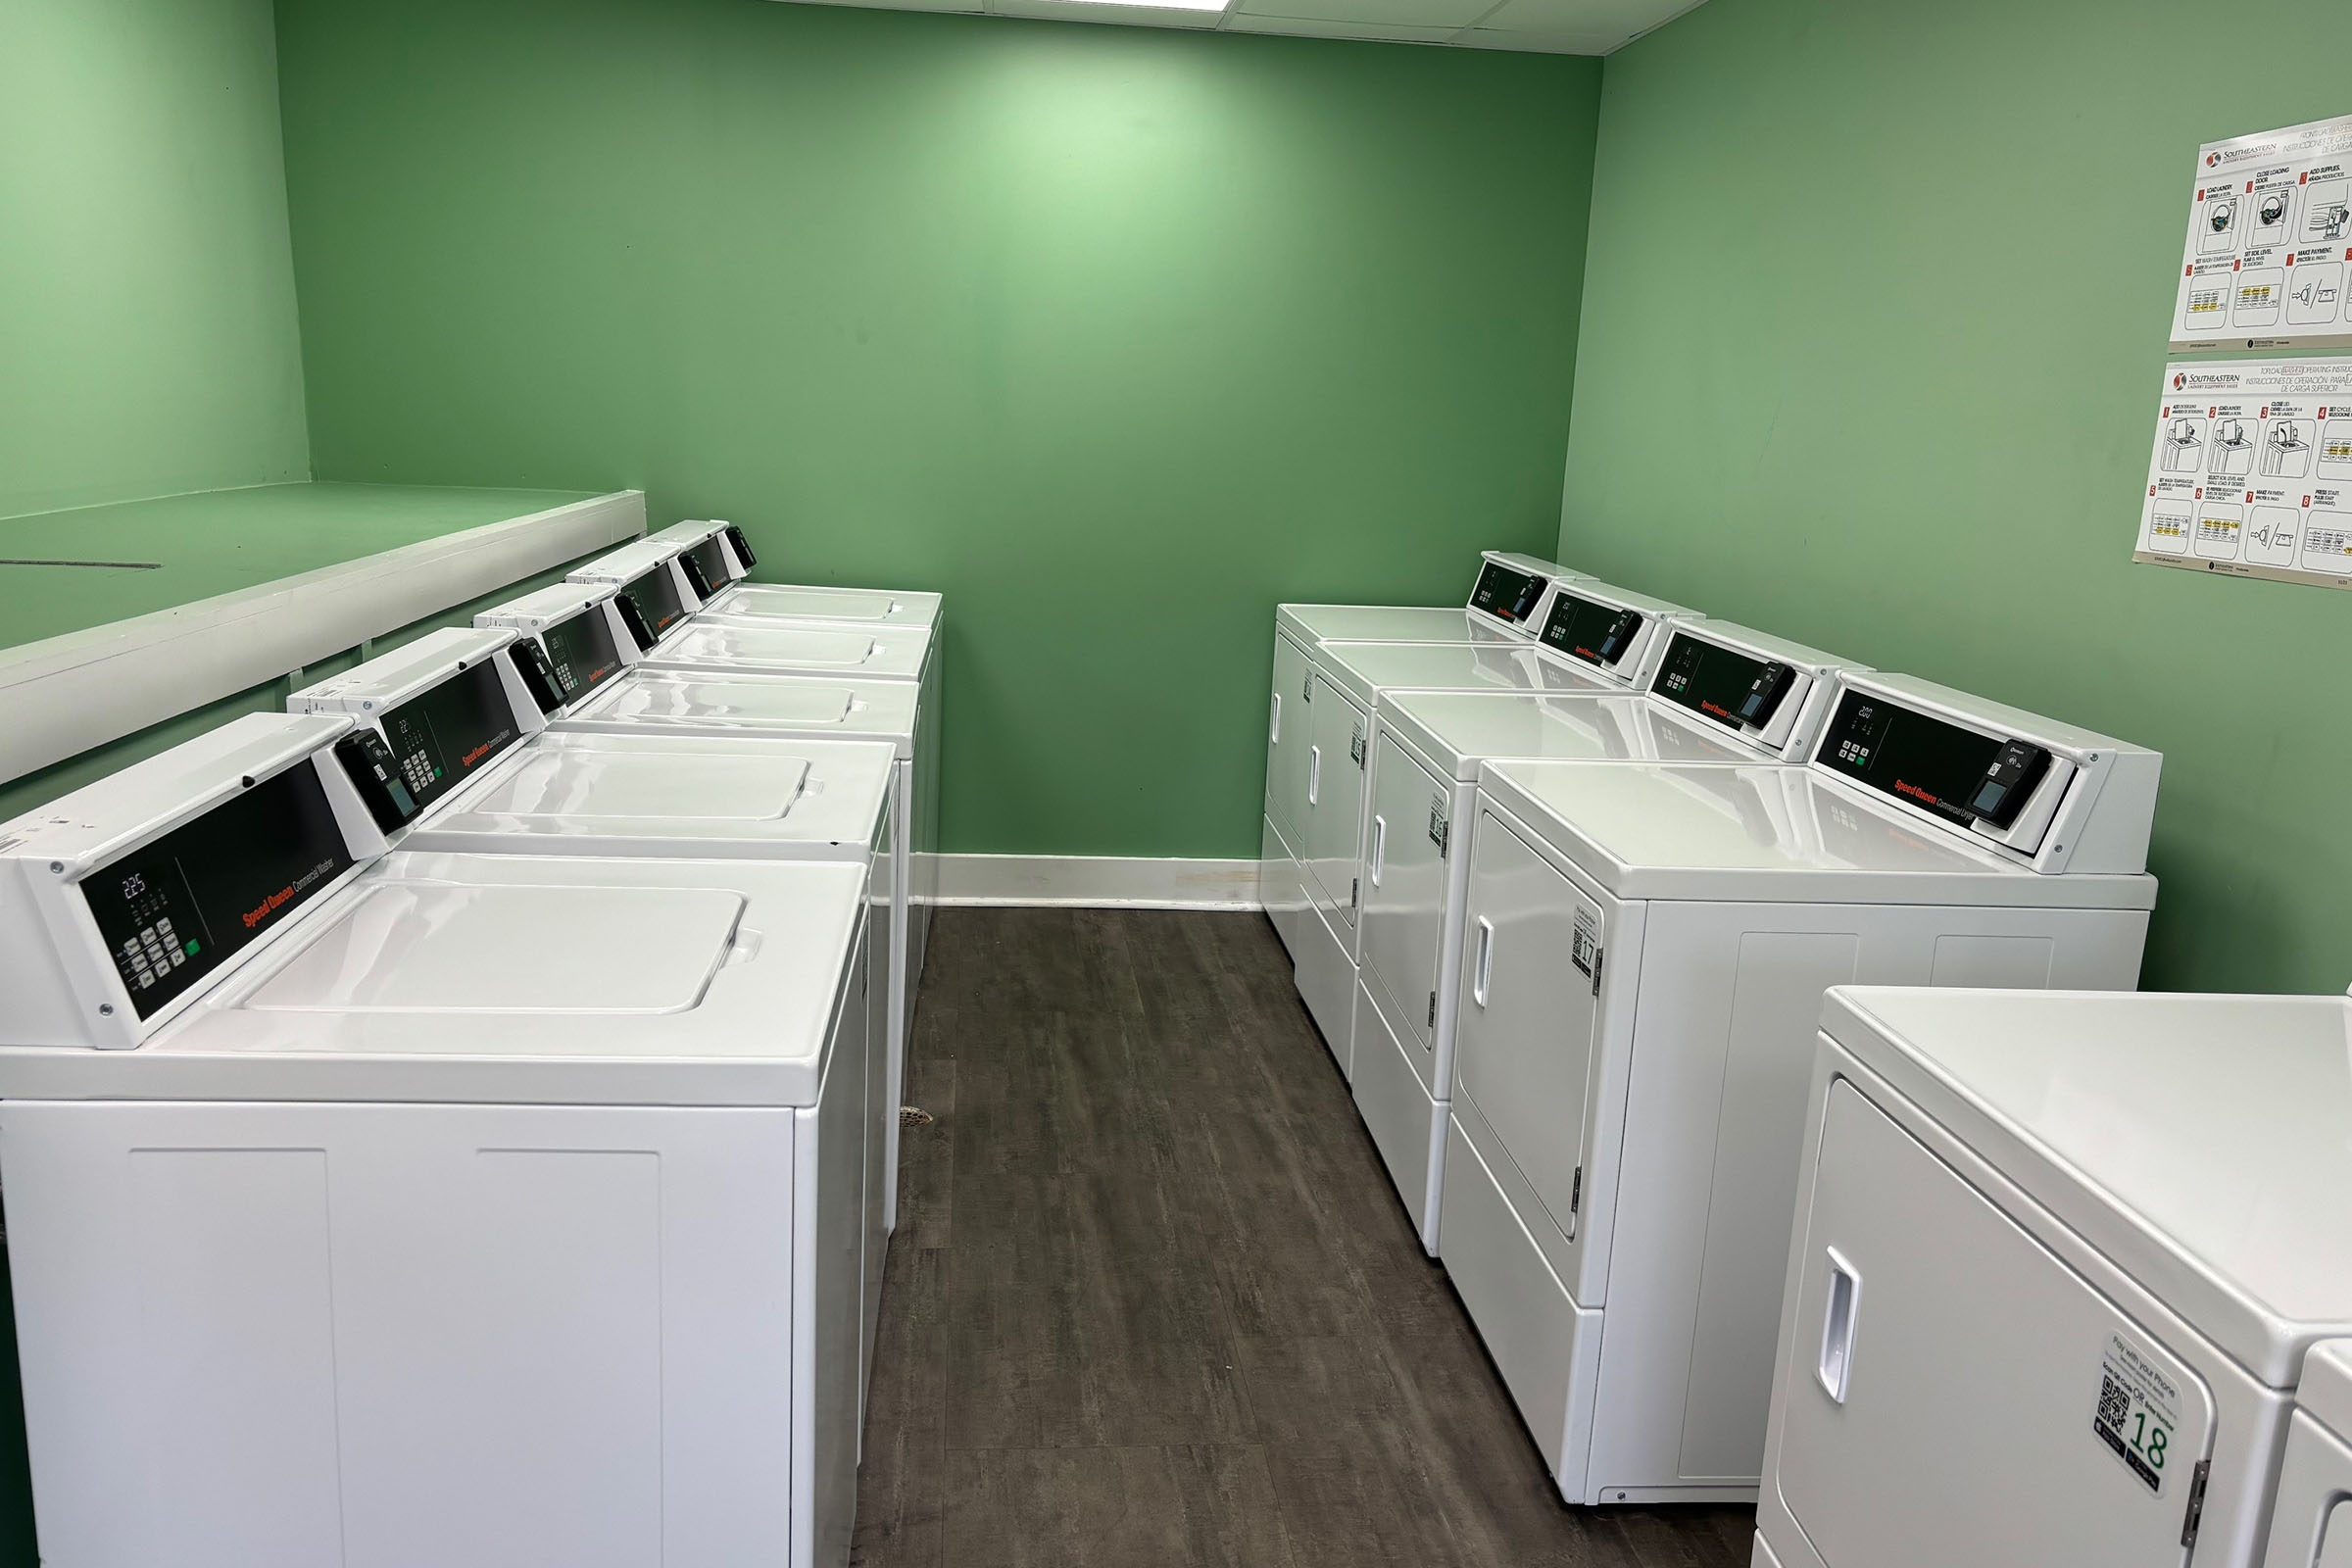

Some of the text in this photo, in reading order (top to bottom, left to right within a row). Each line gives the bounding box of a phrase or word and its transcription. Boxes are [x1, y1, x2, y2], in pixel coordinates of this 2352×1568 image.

[2189, 373, 2240, 383] SOUTHEASTERN
[1894, 779, 1917, 795] Speed
[1915, 787, 1937, 805] Queen
[1936, 798, 1963, 815] Commercial
[242, 858, 334, 927] Speed Queen Commercial Washer
[1583, 940, 1593, 964] 17
[2113, 1336, 2176, 1398] Pay with your Phone
[2120, 1378, 2132, 1394] Code
[2132, 1388, 2145, 1403] OR
[2130, 1412, 2167, 1469] 18
